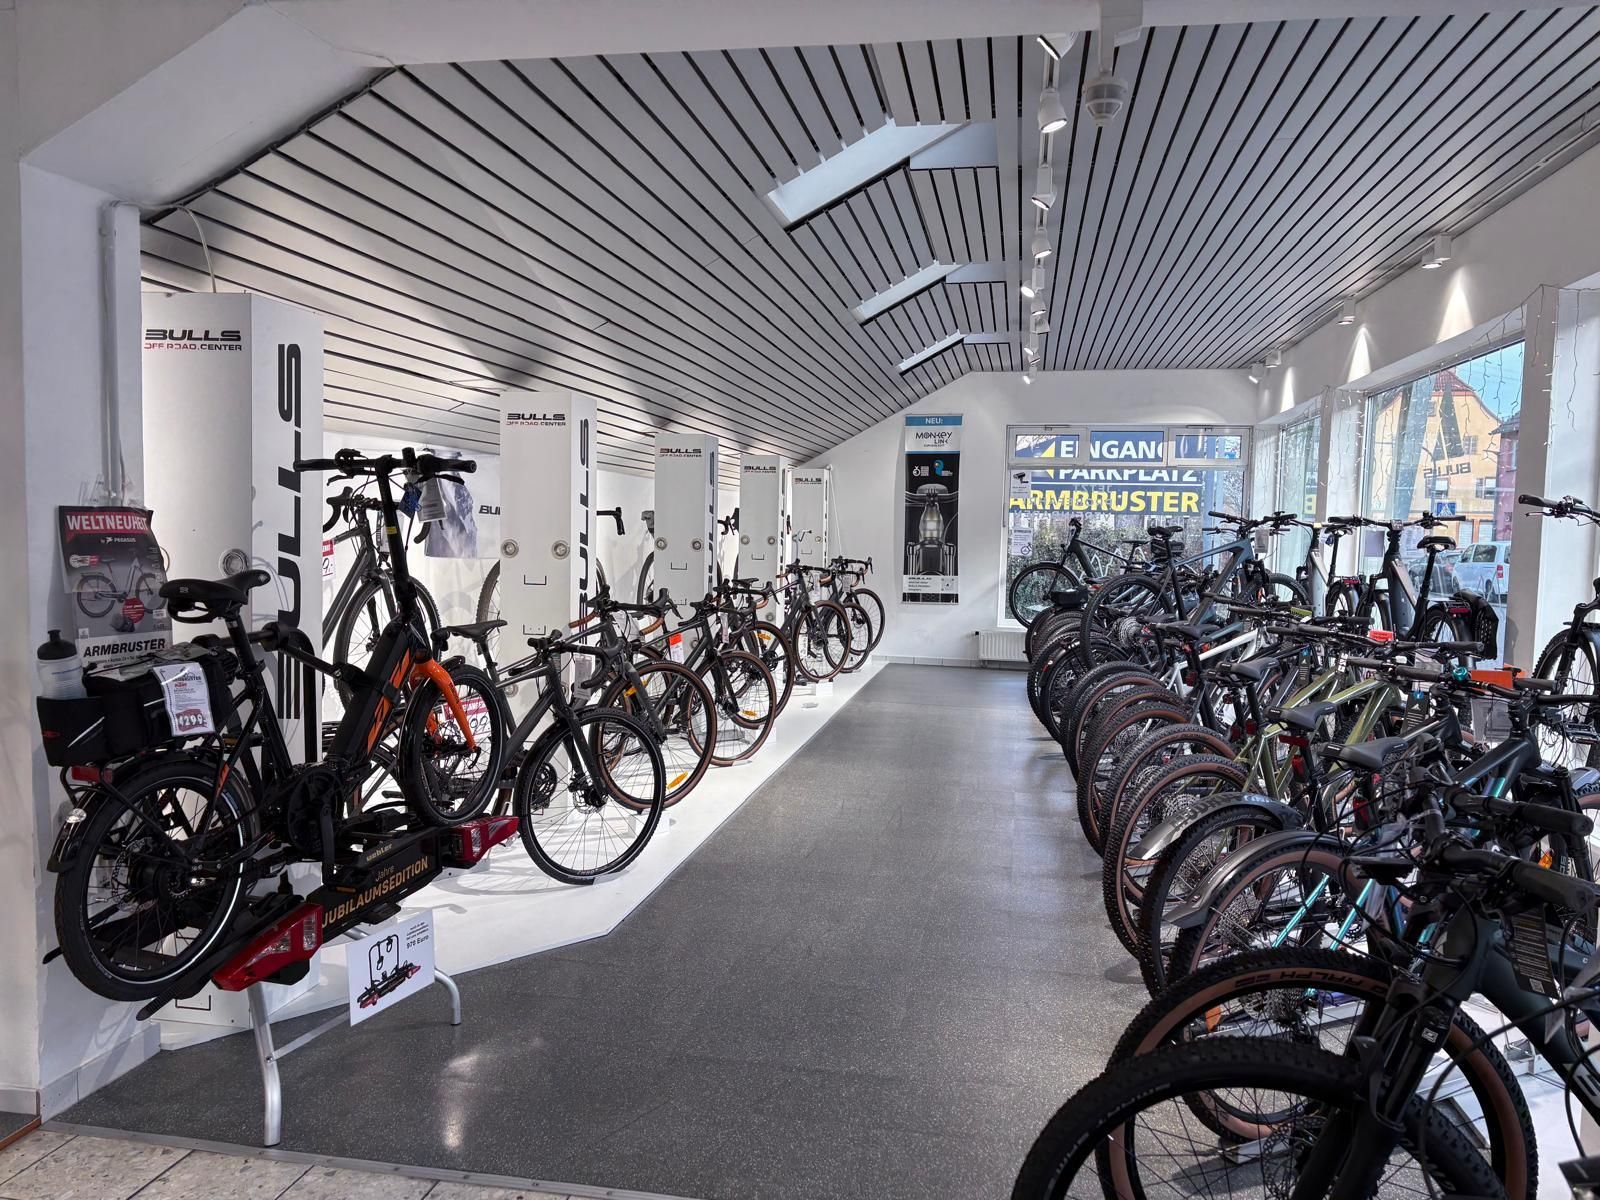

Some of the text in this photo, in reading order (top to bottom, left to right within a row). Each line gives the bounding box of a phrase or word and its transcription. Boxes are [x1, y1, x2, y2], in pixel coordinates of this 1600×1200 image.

[145, 329, 241, 341] BULLS
[507, 413, 566, 421] BULLS
[925, 417, 944, 425] NEU:
[479, 504, 500, 516] BU
[83, 638, 167, 658] ARMBRUSTER
